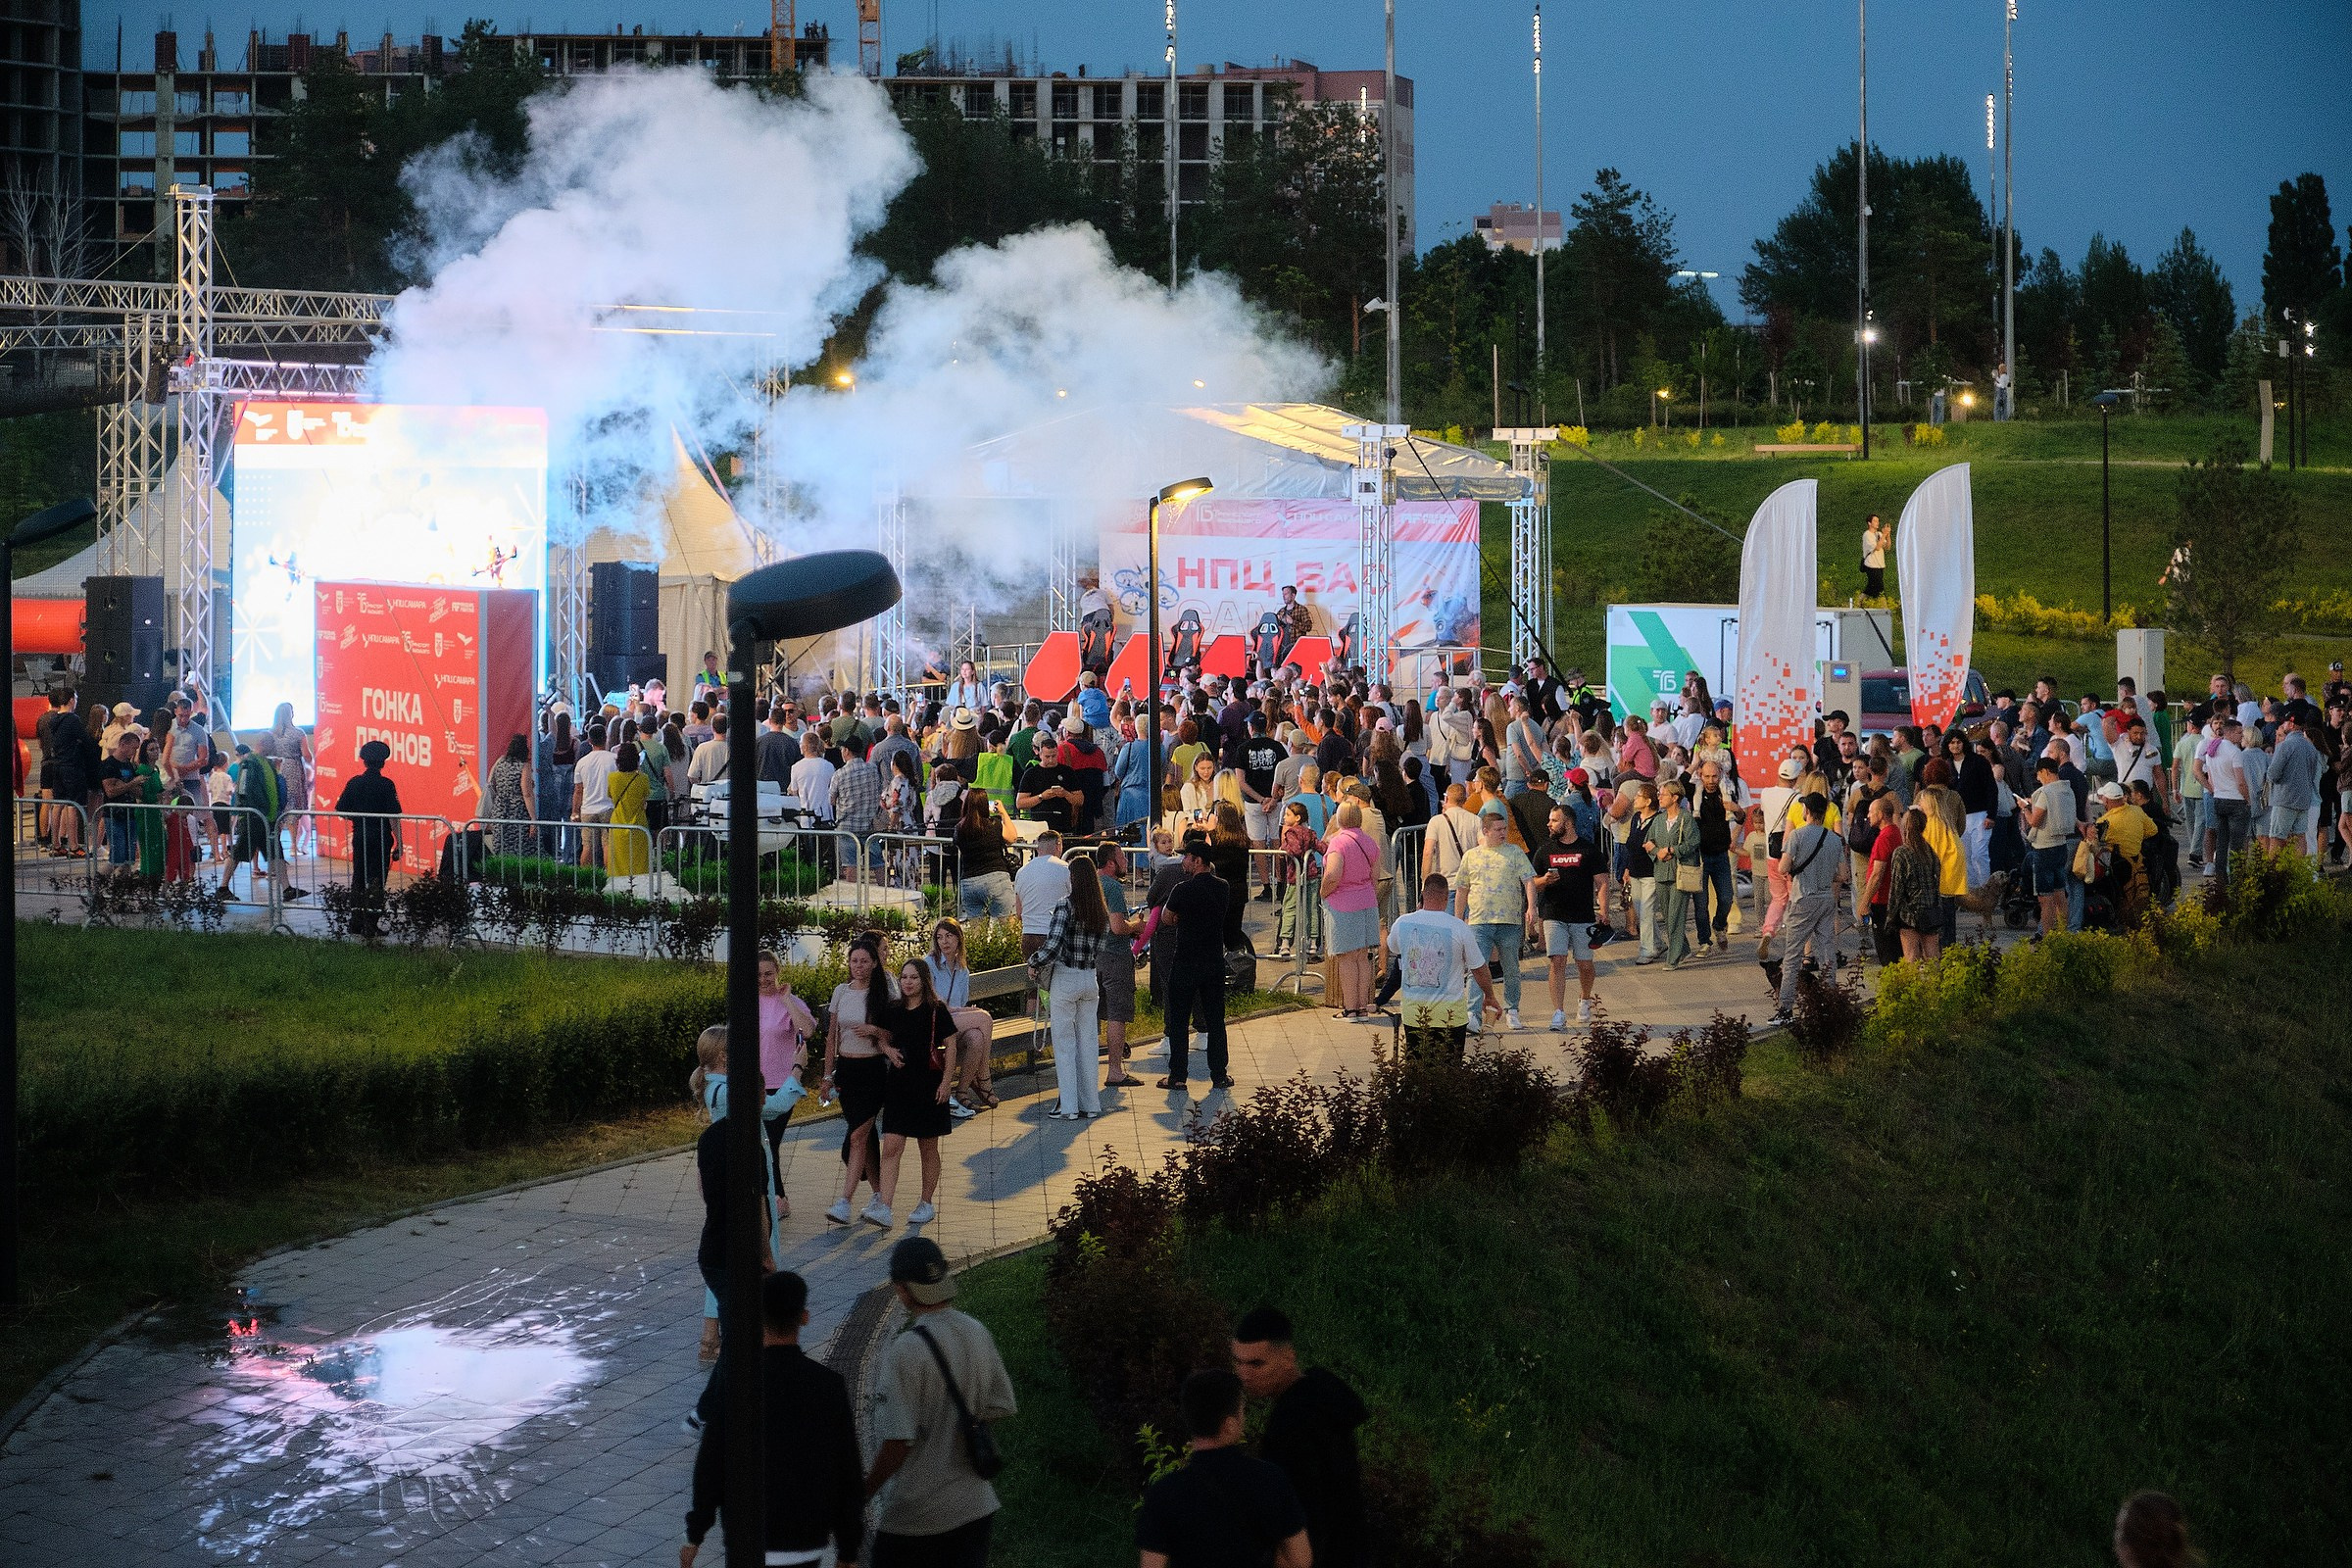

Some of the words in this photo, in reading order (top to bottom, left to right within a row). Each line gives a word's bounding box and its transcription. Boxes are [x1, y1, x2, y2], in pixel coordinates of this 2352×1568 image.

[1177, 557, 1276, 598] НПЦ
[1296, 561, 1391, 596] БАС
[362, 687, 423, 725] ГОНКА
